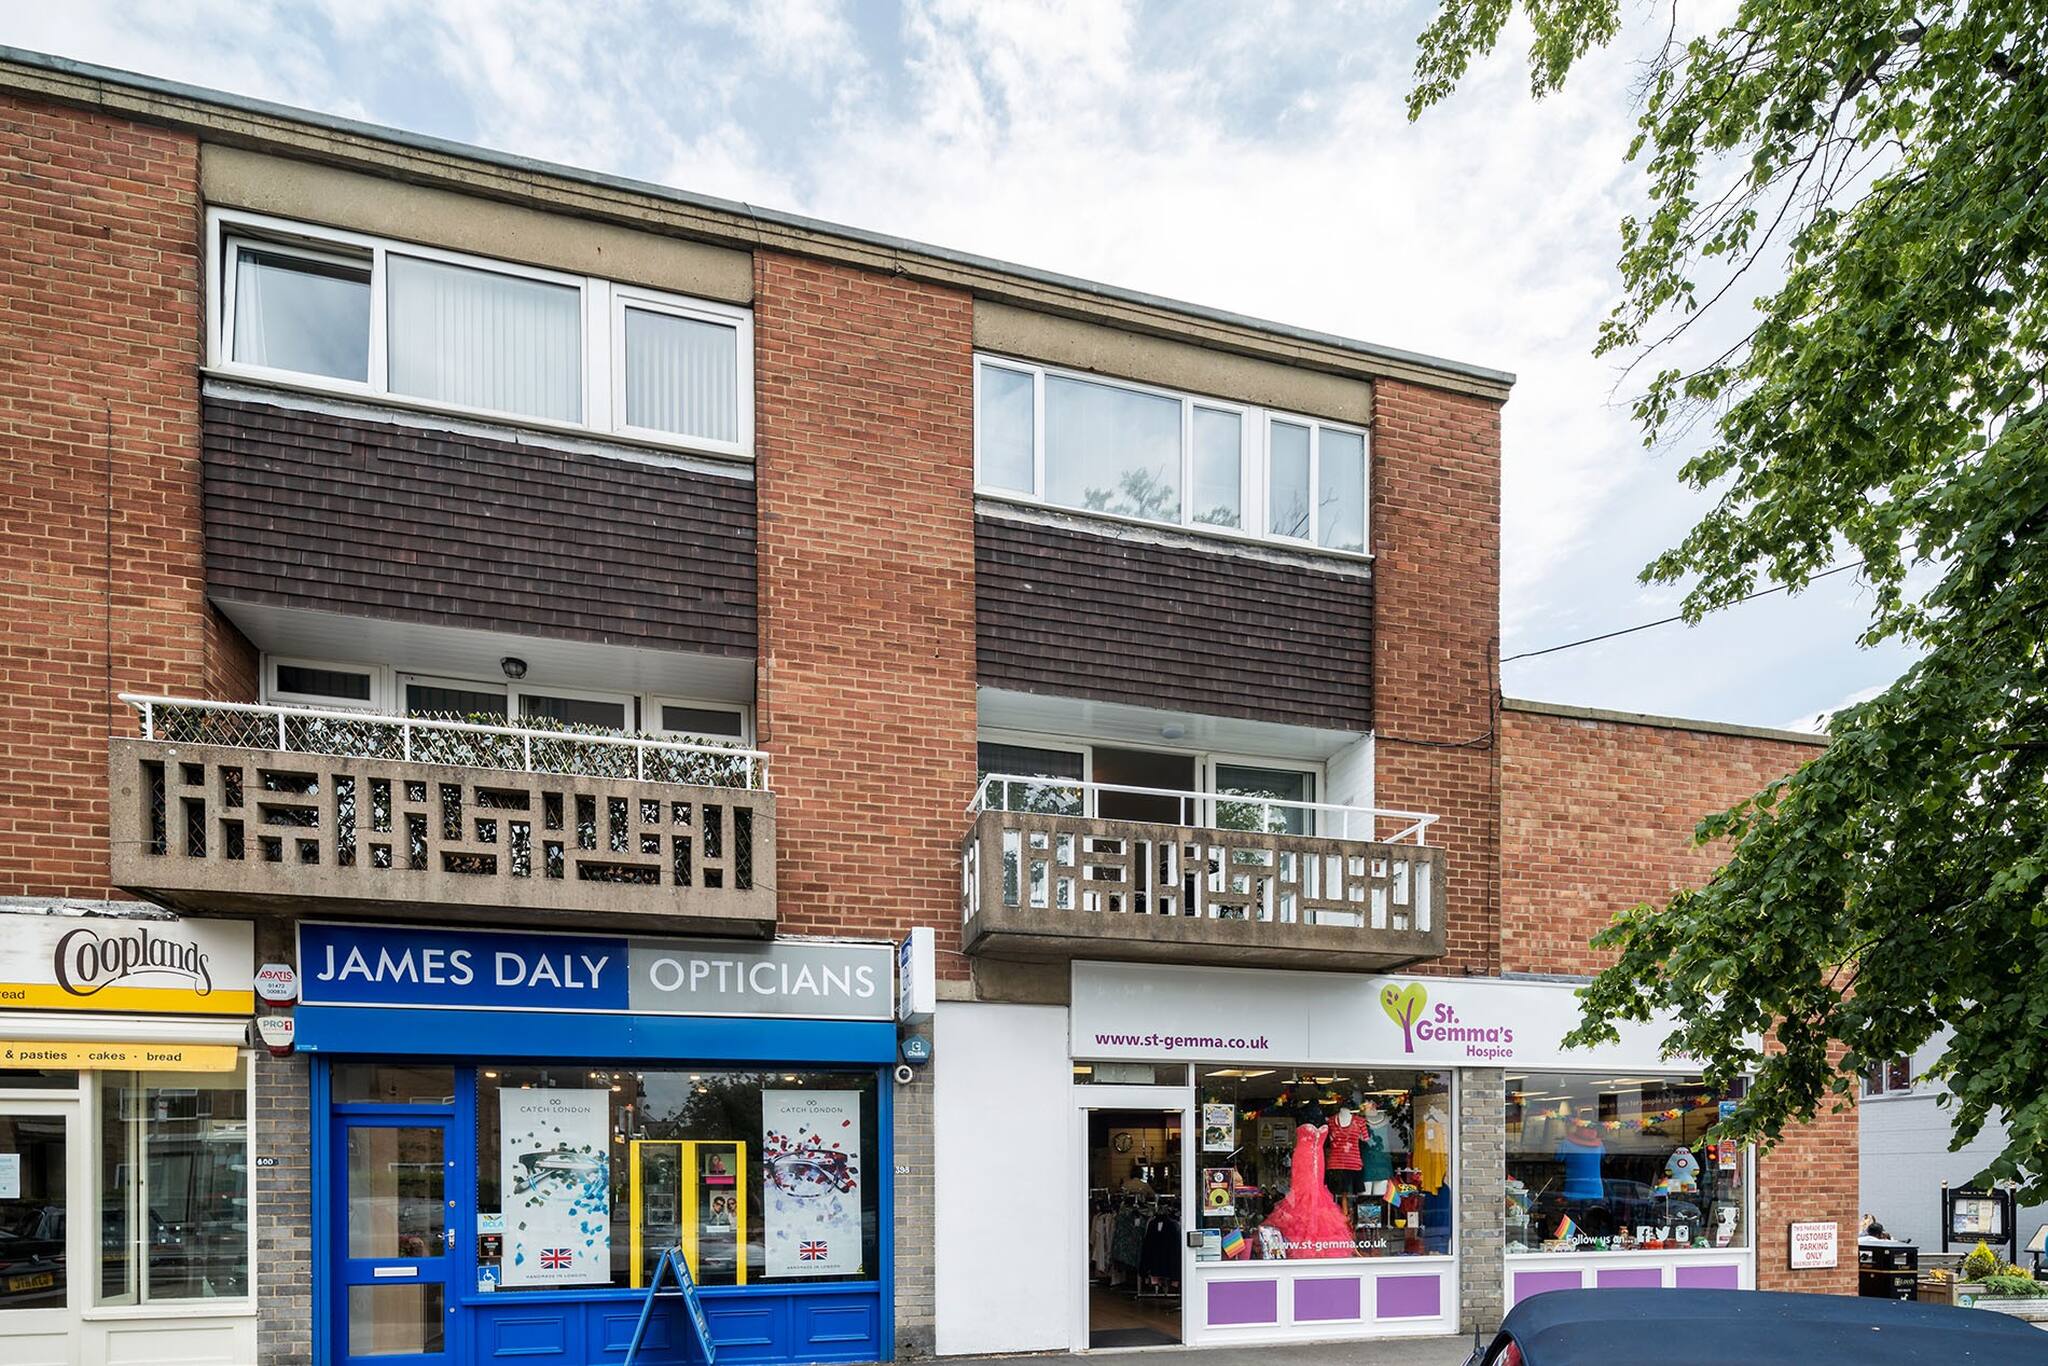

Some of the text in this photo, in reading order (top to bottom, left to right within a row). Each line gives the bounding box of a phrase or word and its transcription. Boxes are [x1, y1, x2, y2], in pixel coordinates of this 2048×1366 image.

[54, 928, 212, 997] Cooplands
[317, 944, 609, 989] JAMES DALY
[260, 970, 293, 980] ABATIS
[649, 958, 876, 998] OPTICIANS
[0, 990, 25, 1000] ead
[1434, 1003, 1460, 1024] St.
[1416, 1019, 1513, 1043] Gemma's
[1095, 1033, 1269, 1050] www.st-gemma.co.uk
[5, 1049, 182, 1062] & pasties cakes bread
[1466, 1045, 1513, 1060] Hospice
[1796, 1232, 1833, 1242] CUSTOMER
[1800, 1242, 1829, 1251] PARKING
[1805, 1252, 1823, 1260] ONLY
